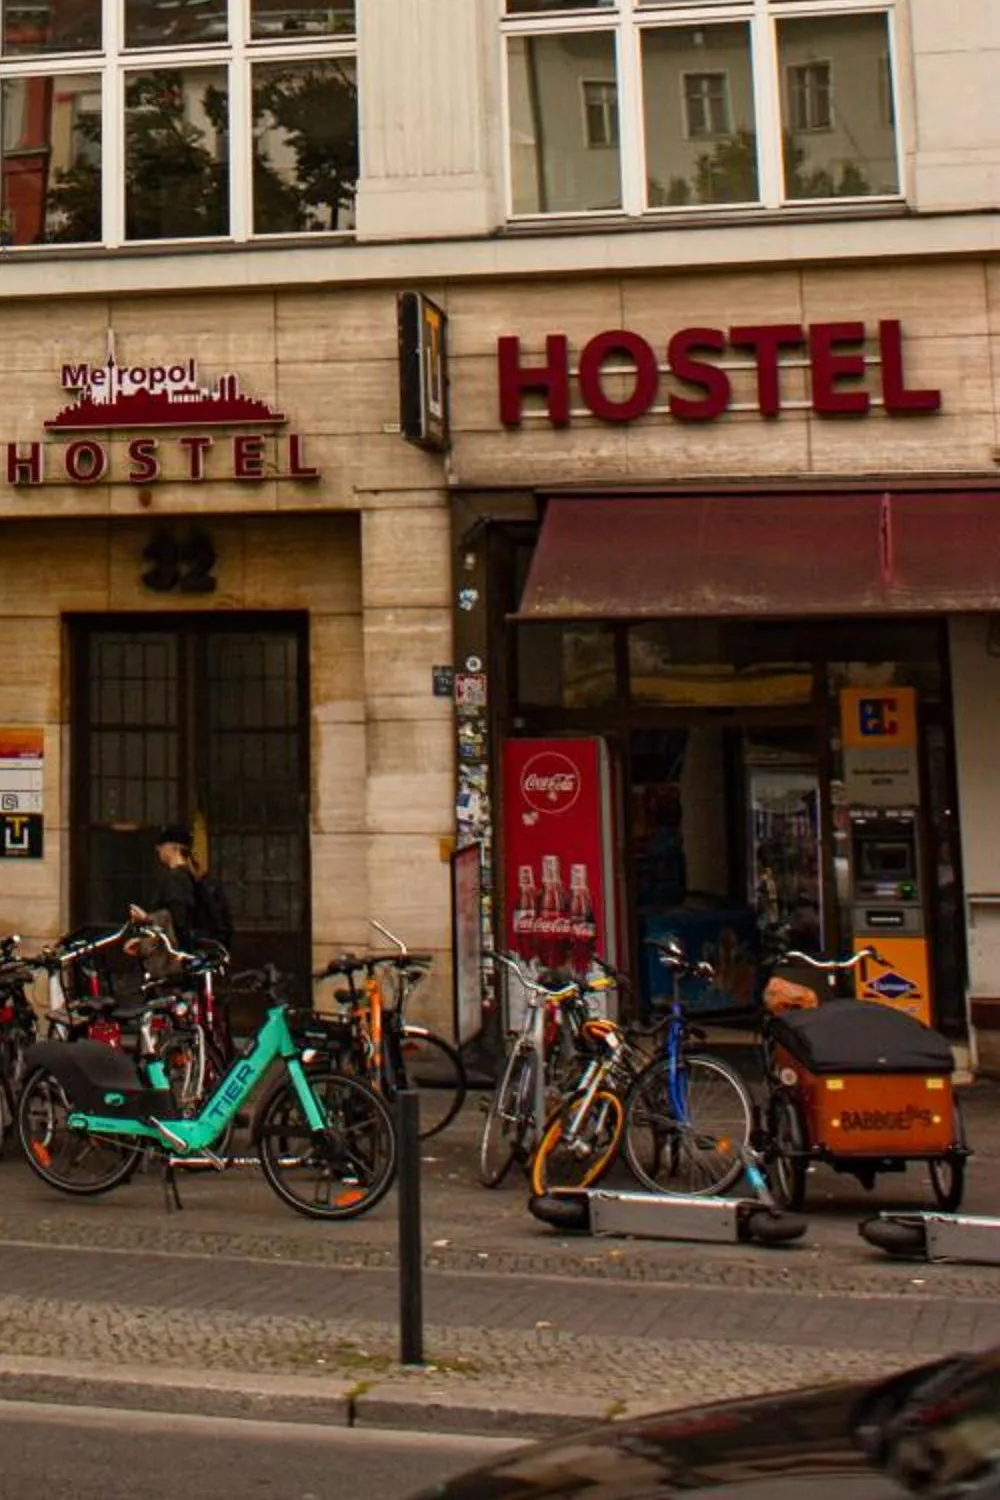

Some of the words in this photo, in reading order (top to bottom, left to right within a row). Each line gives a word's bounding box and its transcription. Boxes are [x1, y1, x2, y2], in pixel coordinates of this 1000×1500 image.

[61, 358, 195, 389] Metropol
[498, 319, 941, 426] HOSTEL
[6, 434, 318, 485] HOSTEL
[208, 1063, 256, 1120] TIER
